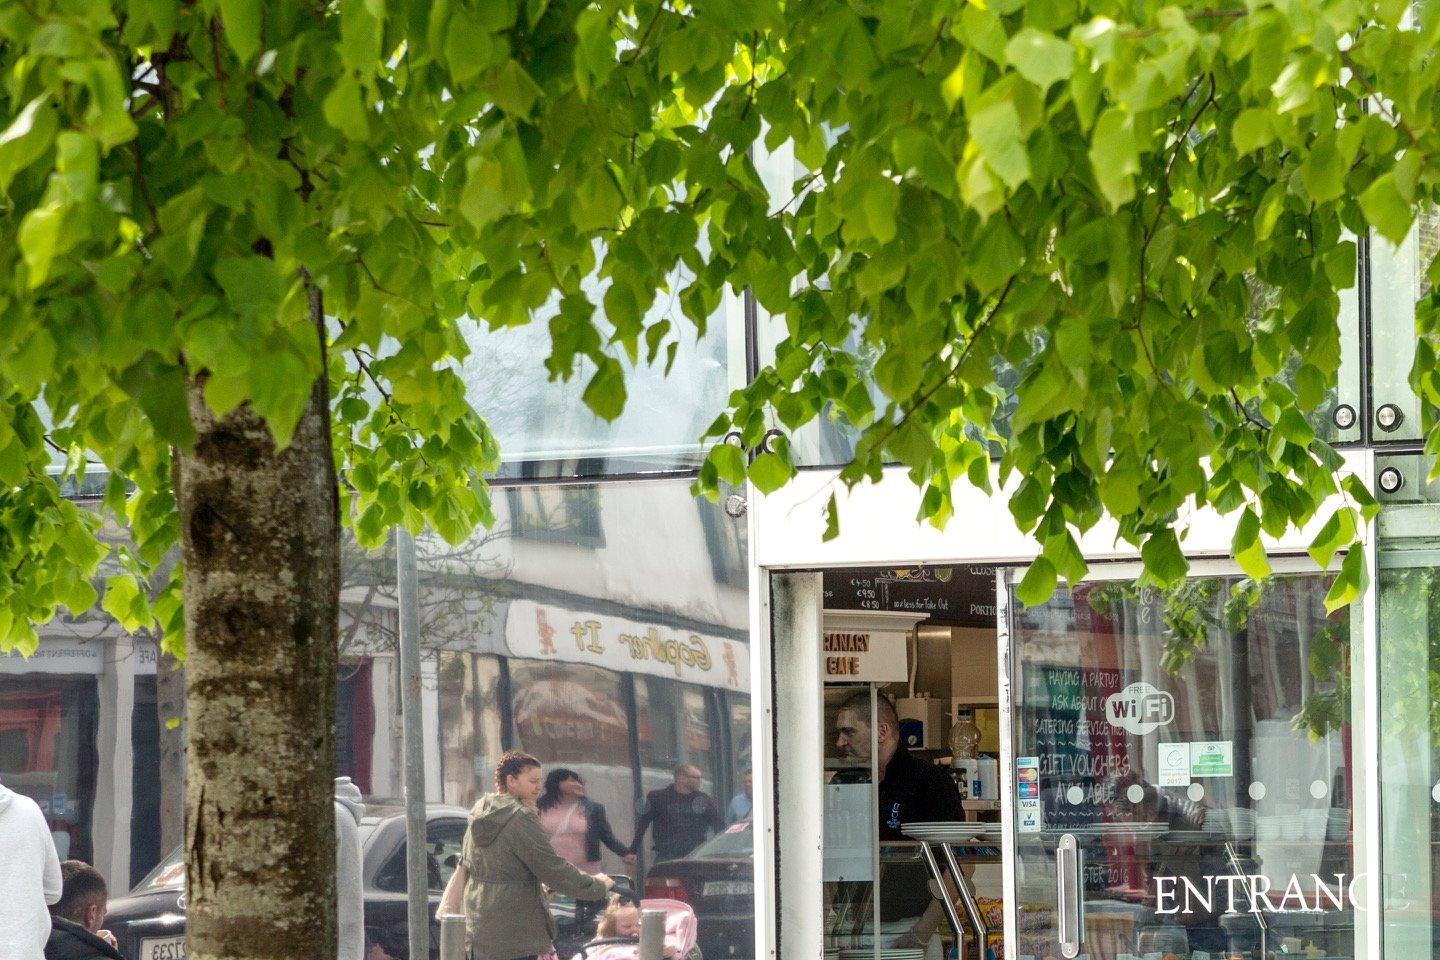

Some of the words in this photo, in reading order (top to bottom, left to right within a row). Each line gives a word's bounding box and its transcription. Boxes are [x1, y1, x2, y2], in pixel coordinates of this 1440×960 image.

[970, 603, 997, 616] PORTIO
[823, 633, 871, 652] RANARY
[1048, 670, 1080, 686] HAVING
[1082, 673, 1088, 688] A
[1089, 672, 1119, 688] PARTY?
[1128, 686, 1151, 695] FREE
[1051, 694, 1069, 711] ASK
[1071, 696, 1098, 711] ABOUT
[1035, 718, 1075, 734] CATERING
[1040, 753, 1065, 775] GIFT
[1069, 754, 1131, 777] VOUCHERS
[1055, 780, 1115, 805] AVLABLE
[1083, 866, 1105, 884] STER
